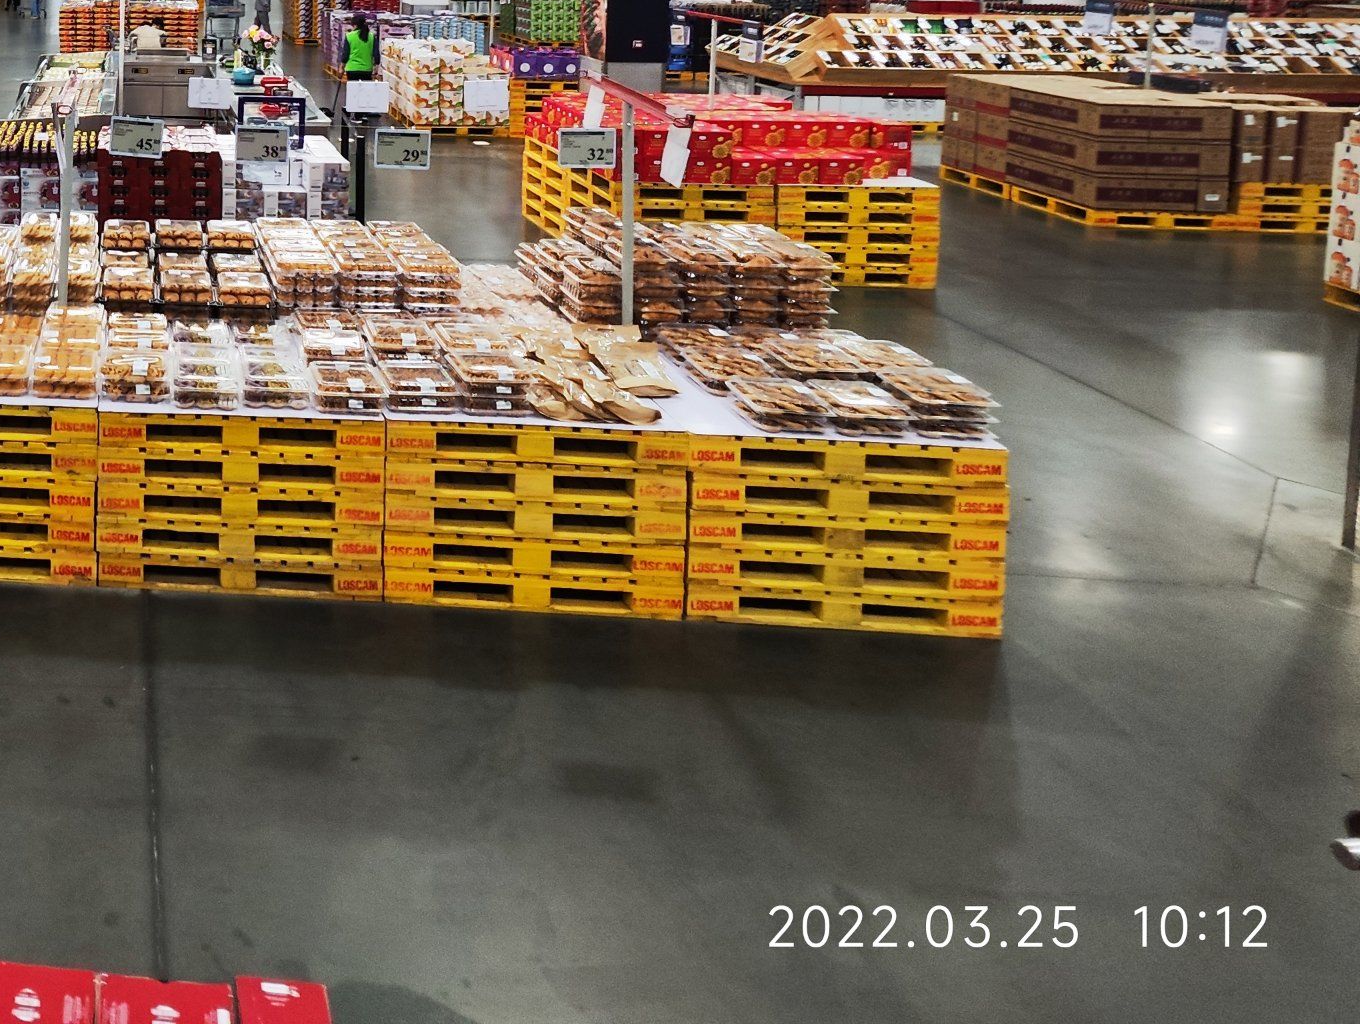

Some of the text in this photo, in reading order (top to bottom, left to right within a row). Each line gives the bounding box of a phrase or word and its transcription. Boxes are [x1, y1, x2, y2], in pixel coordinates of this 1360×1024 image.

[261, 145, 279, 158] 38
[402, 149, 420, 162] 29
[586, 148, 605, 161] 32
[54, 420, 97, 433] LOSCAM
[102, 426, 144, 439] LOSCAM
[340, 435, 382, 447] LOSCAM
[390, 436, 434, 449] LOSCAM
[691, 449, 735, 462] LOSCAM
[101, 461, 141, 474] LOSCAM
[956, 463, 1002, 476] LOSCAM
[340, 471, 381, 483] LOSCAM
[51, 494, 92, 507] LOSCAM
[696, 487, 740, 501] LOSCAM
[100, 497, 140, 510] LOSCAM
[958, 501, 1004, 515] LOSCAM
[51, 529, 91, 543] LOSCAM
[99, 531, 139, 544] LOSCAM
[693, 525, 737, 538] LOSCAM
[336, 542, 377, 555] LOSCAM
[953, 539, 1000, 552] LOSCAM
[53, 564, 93, 578] LOSCAM
[101, 564, 141, 577] LOSCAM
[691, 561, 735, 575] LOSCAM
[337, 578, 379, 591] LOSCAM
[952, 577, 999, 591] LOSCAM
[690, 599, 734, 612] LOSCAM
[951, 613, 998, 627] LOSCAM
